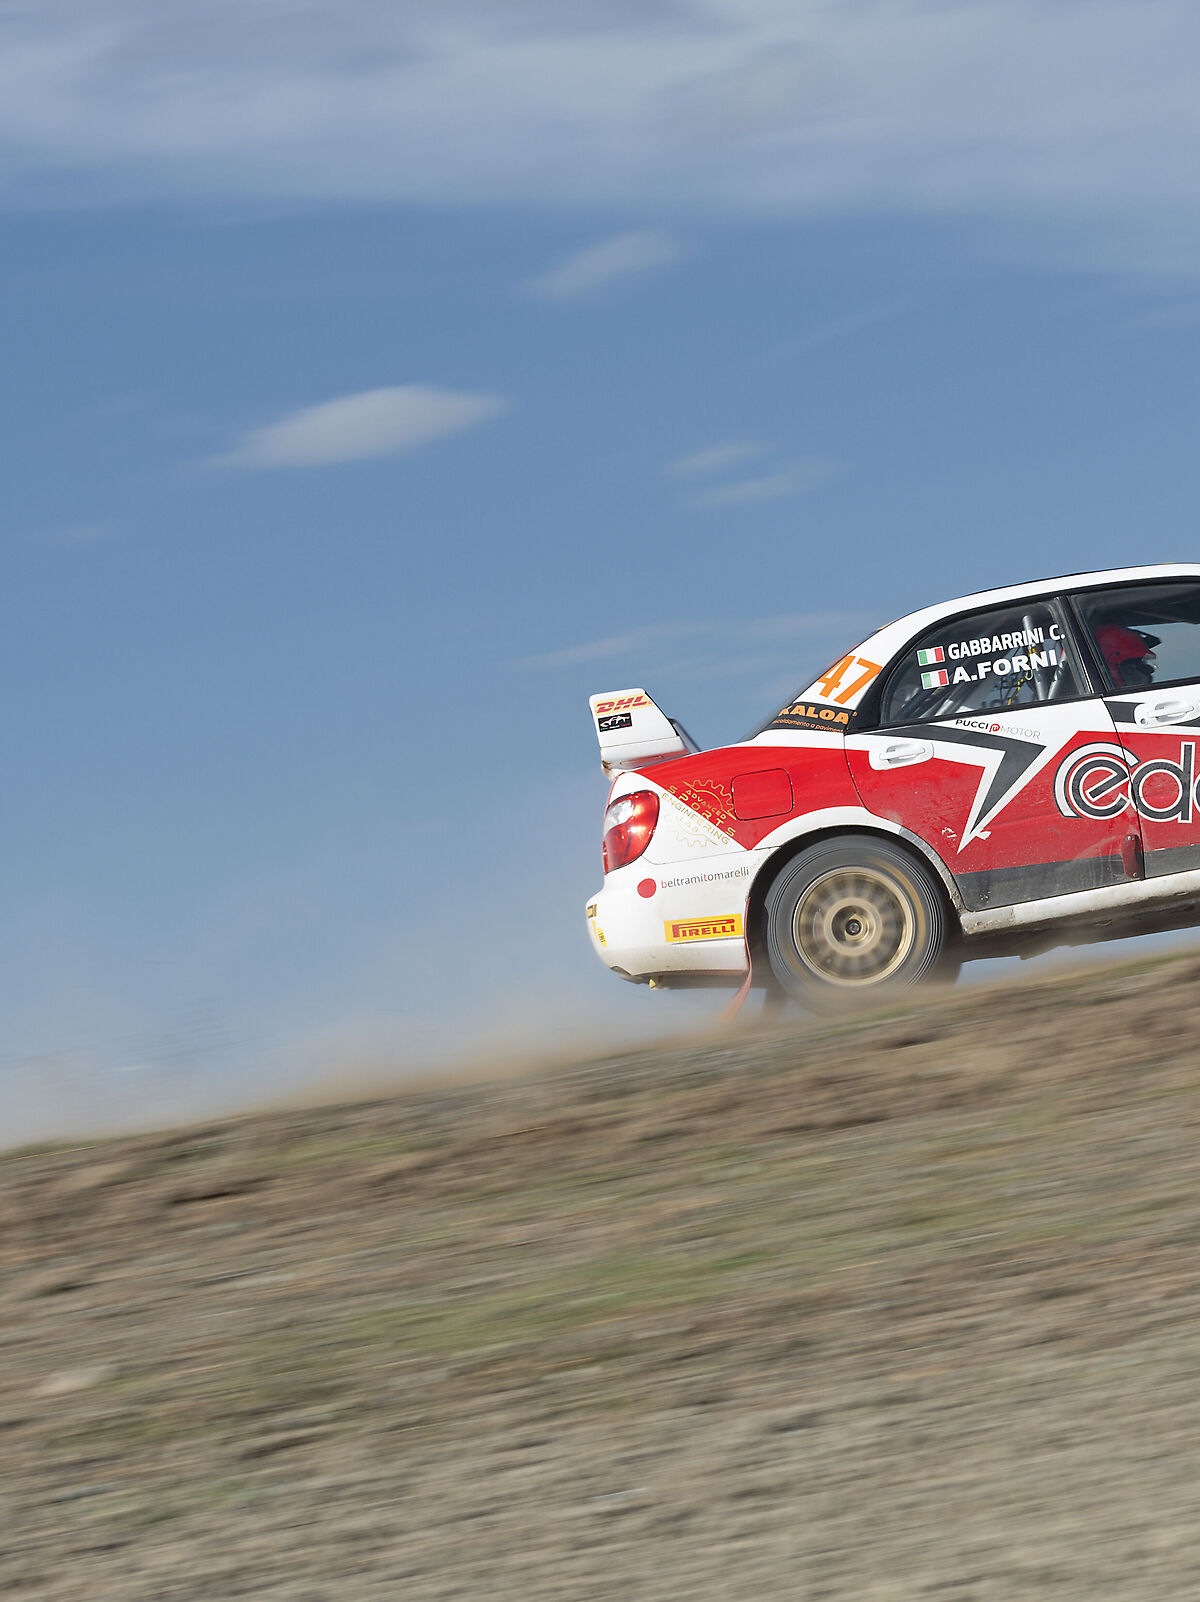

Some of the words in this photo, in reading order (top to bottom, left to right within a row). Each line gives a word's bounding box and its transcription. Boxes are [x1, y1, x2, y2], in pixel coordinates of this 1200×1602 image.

[948, 627, 1044, 660] GABBARRINI
[1049, 624, 1066, 640] C.
[818, 655, 883, 705] 47
[952, 649, 1057, 685] A.FORNI
[597, 696, 647, 713] DHL
[955, 719, 989, 730] PUCCI
[1000, 726, 1041, 740] MOTOR
[662, 792, 730, 845] ENGINEERING
[668, 785, 736, 837] SPORTS
[686, 790, 727, 820] ADVANCED
[661, 866, 749, 889] beltramitomarelli
[672, 919, 735, 938] PIRELLI
